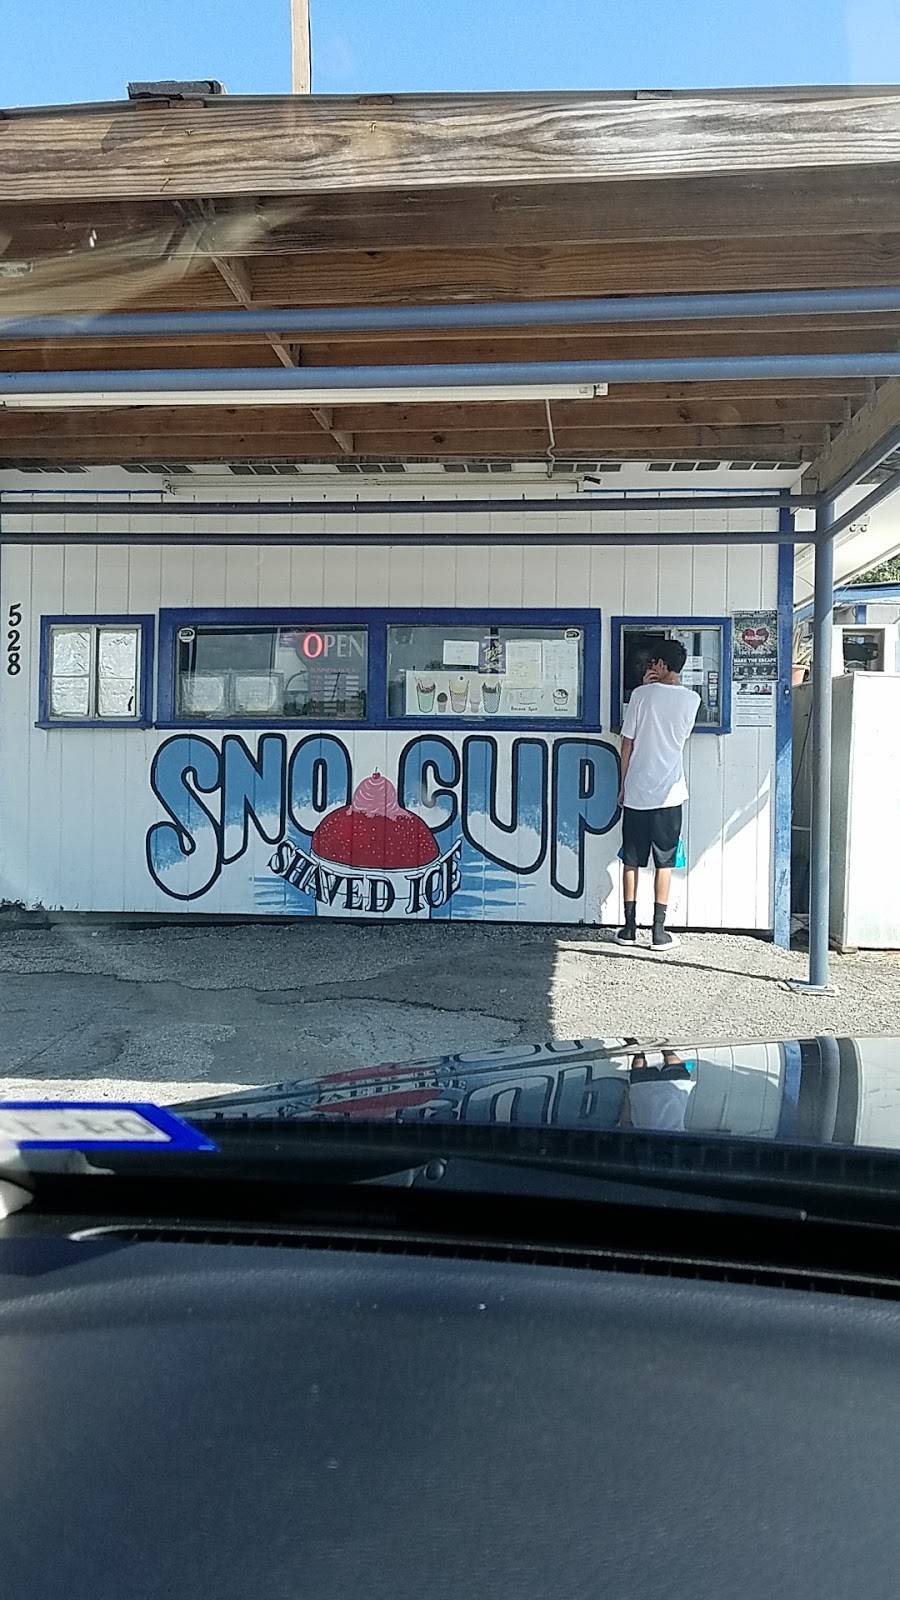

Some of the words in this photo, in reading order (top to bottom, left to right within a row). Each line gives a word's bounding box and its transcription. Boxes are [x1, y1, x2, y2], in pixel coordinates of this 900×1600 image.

[7, 602, 22, 676] 528
[303, 632, 364, 658] OPEN
[146, 734, 353, 900] SNO
[400, 735, 621, 897] CUP
[267, 838, 396, 913] SHAVED
[404, 839, 462, 914] ICE
